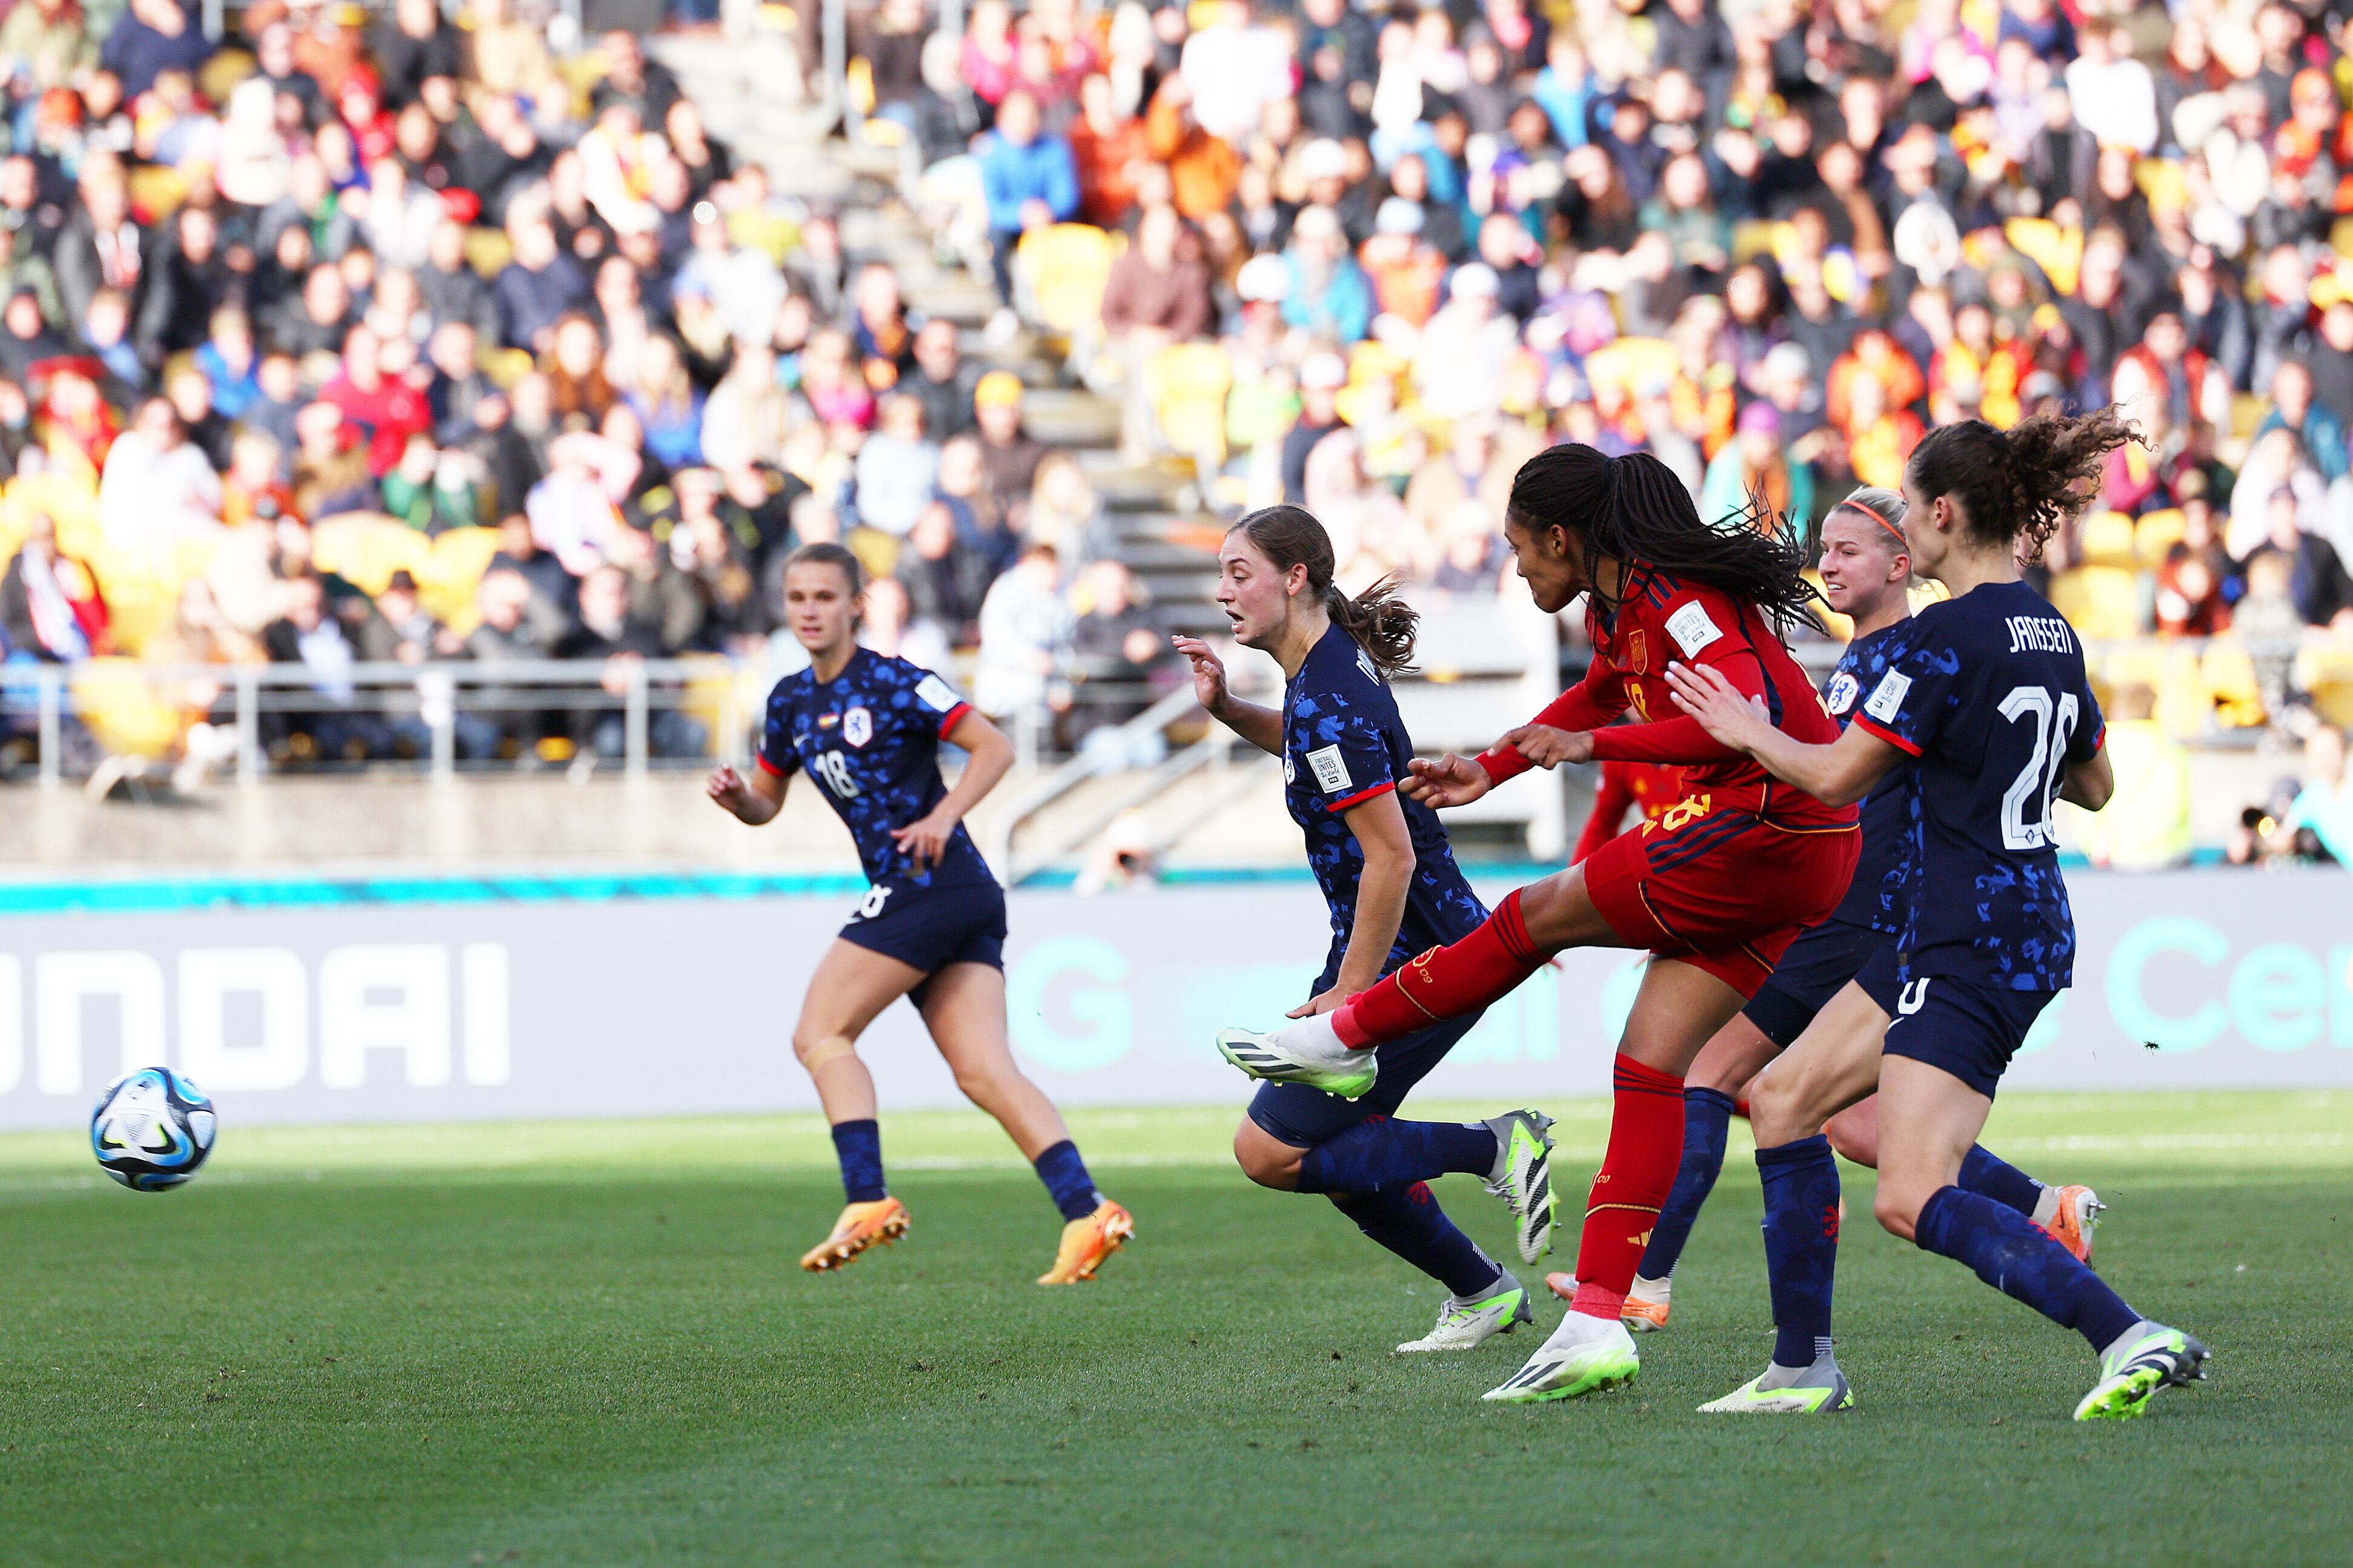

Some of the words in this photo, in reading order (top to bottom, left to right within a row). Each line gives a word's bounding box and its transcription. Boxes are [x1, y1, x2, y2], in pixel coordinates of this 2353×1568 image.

[2005, 615, 2073, 655] JANSSEN
[814, 749, 860, 799] 18
[1318, 760, 1336, 772] UNITES
[1997, 686, 2079, 850] 20
[0, 942, 511, 1097] NDAI
[2106, 915, 2353, 1052] Ce
